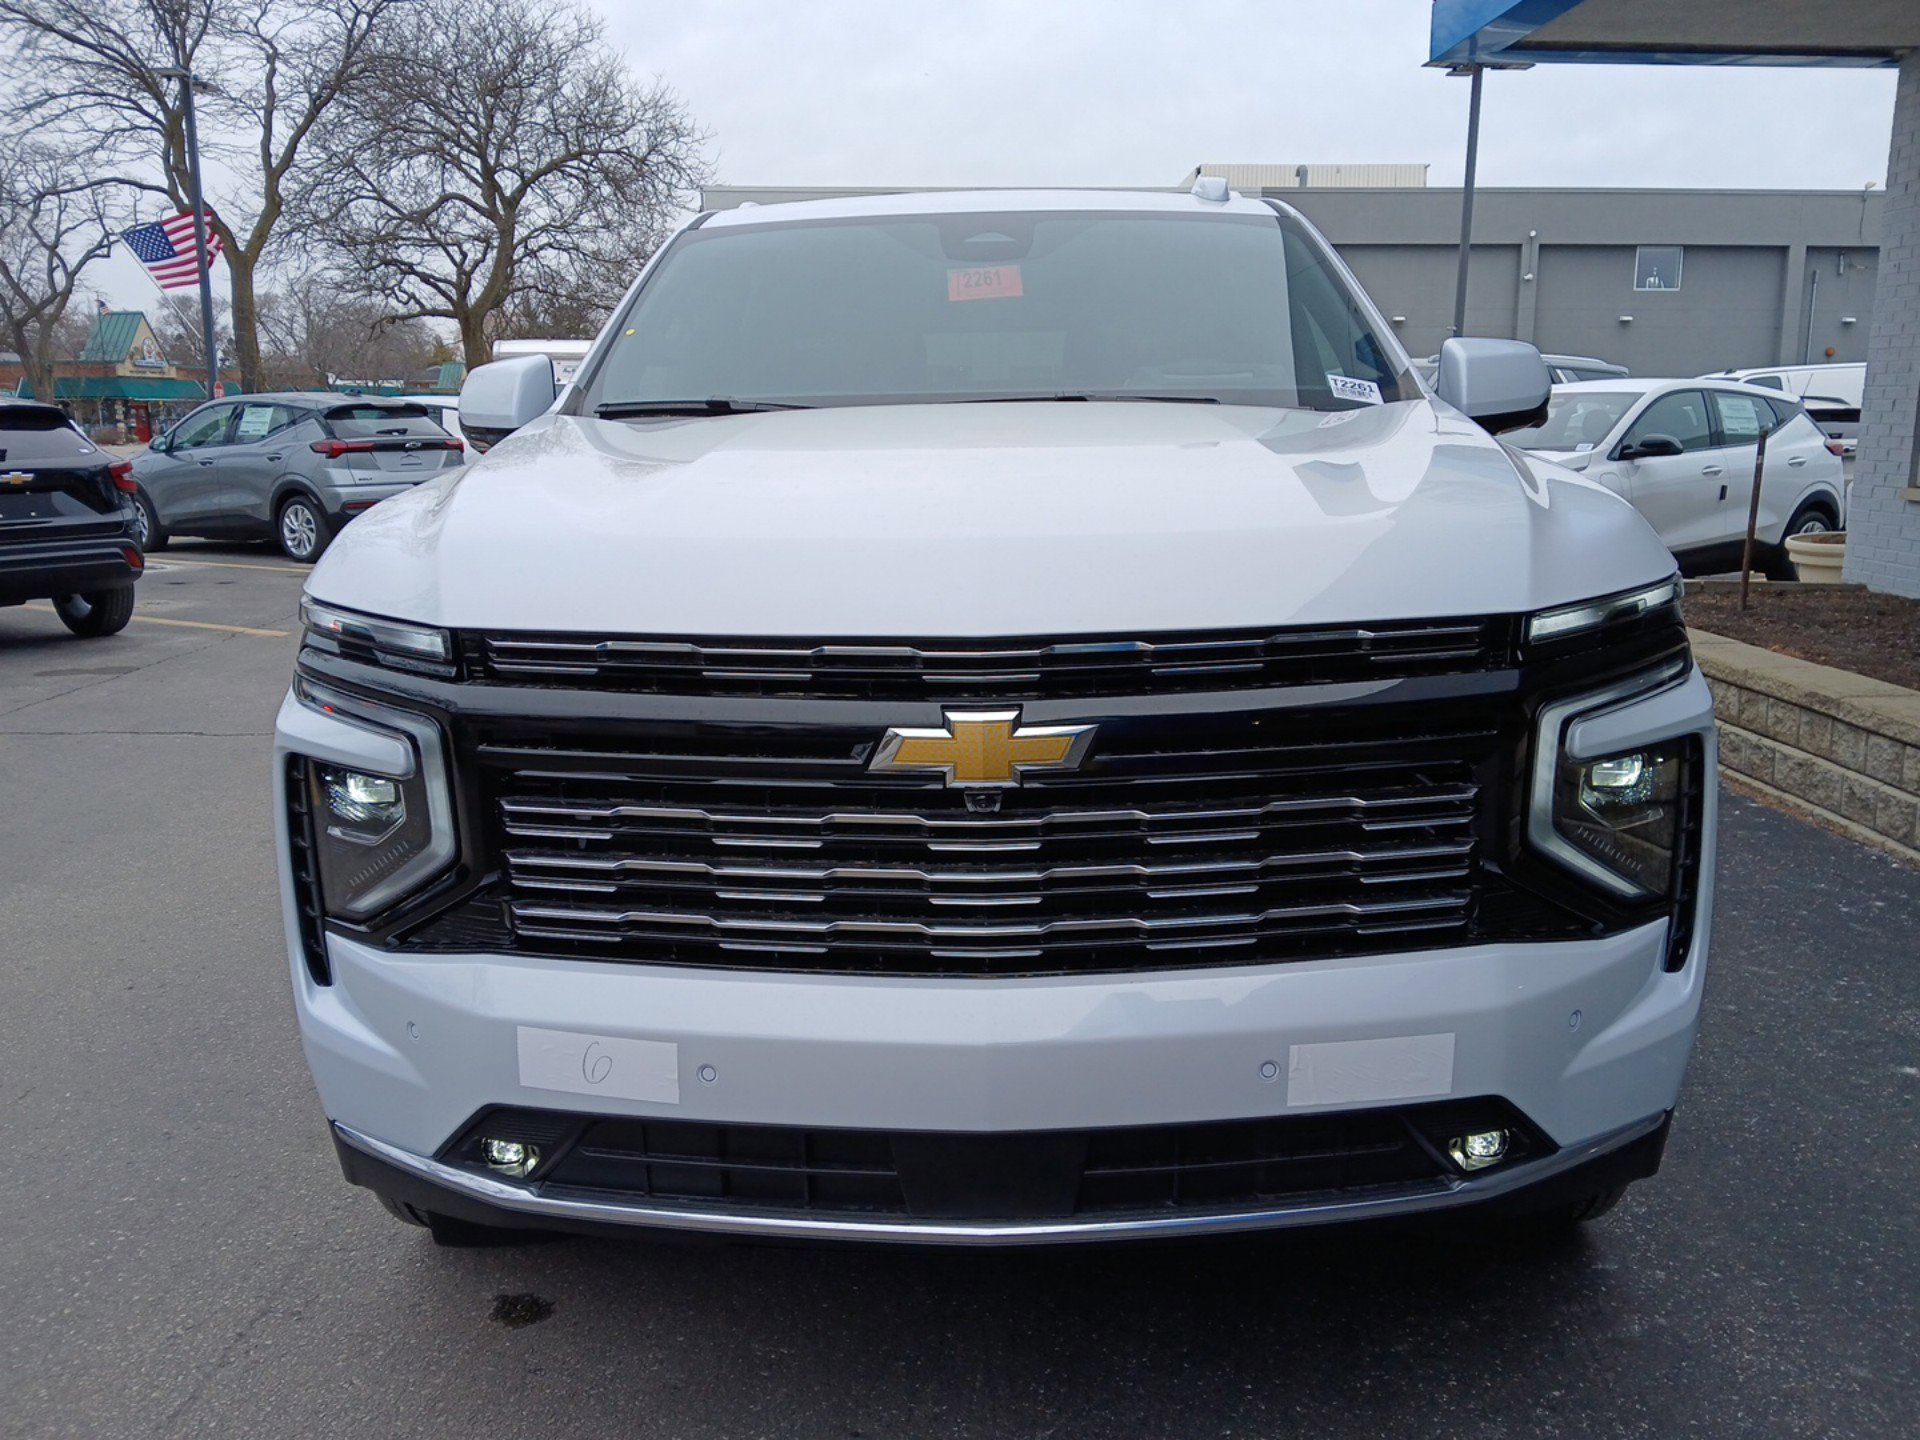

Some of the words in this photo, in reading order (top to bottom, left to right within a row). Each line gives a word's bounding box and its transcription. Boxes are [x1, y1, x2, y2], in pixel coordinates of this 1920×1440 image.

[963, 270, 1002, 288] 2261
[1330, 378, 1375, 393] T2261
[582, 1040, 613, 1085] 6
